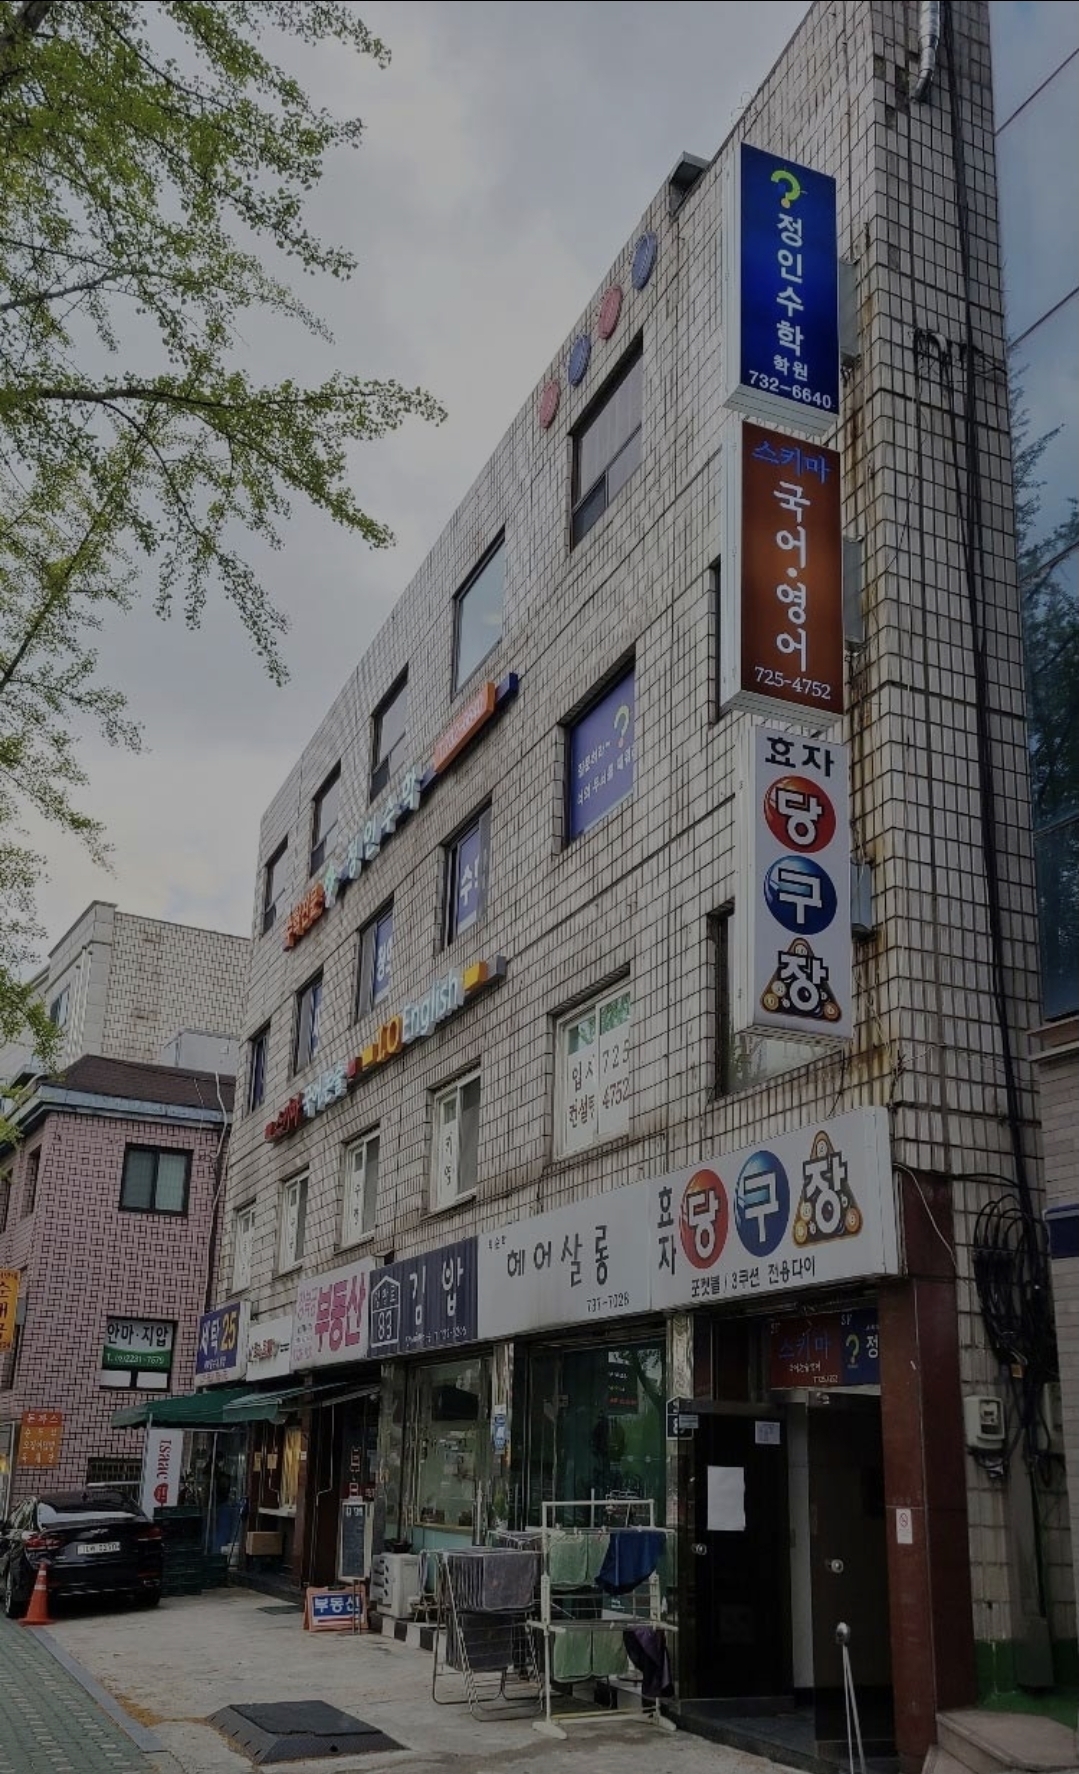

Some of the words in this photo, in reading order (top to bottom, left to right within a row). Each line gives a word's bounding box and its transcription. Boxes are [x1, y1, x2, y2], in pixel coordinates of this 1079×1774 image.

[776, 213, 805, 357] 정인수학
[748, 370, 833, 409] 732-6640
[773, 354, 808, 382] 학원
[751, 440, 832, 485] 스키마
[754, 666, 832, 700] 725-4752
[765, 736, 834, 778] 효자
[775, 786, 829, 1013] 당구장
[402, 966, 462, 1043] English
[657, 1186, 677, 1276] 효자
[686, 1148, 850, 1261] 당구장
[507, 1225, 609, 1288] 헤어살롱
[691, 1275, 720, 1298] 포켓볼
[732, 1266, 760, 1290] 3쿠션
[767, 1255, 816, 1284] 전용다이
[314, 1271, 367, 1353] 부동산
[156, 1440, 172, 1480] Isaac
